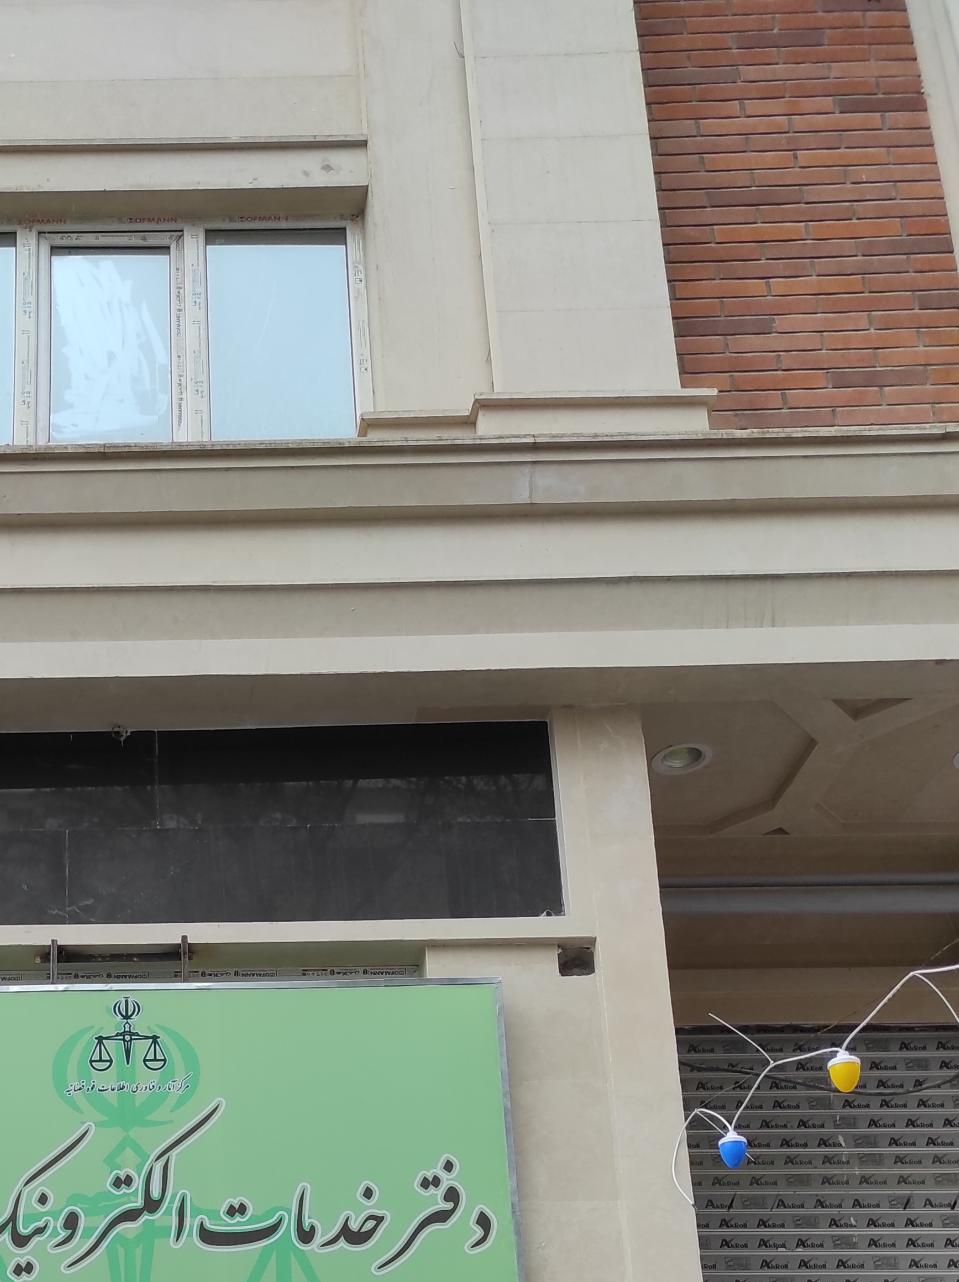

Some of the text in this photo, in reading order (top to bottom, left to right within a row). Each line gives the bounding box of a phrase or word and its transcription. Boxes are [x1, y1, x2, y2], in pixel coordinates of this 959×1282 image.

[97, 1082, 129, 1092] اطلاعات
[156, 1084, 162, 1092] و
[176, 1072, 193, 1094] مرکز
[197, 1184, 387, 1248] خدمات
[375, 1157, 493, 1271] دفتر
